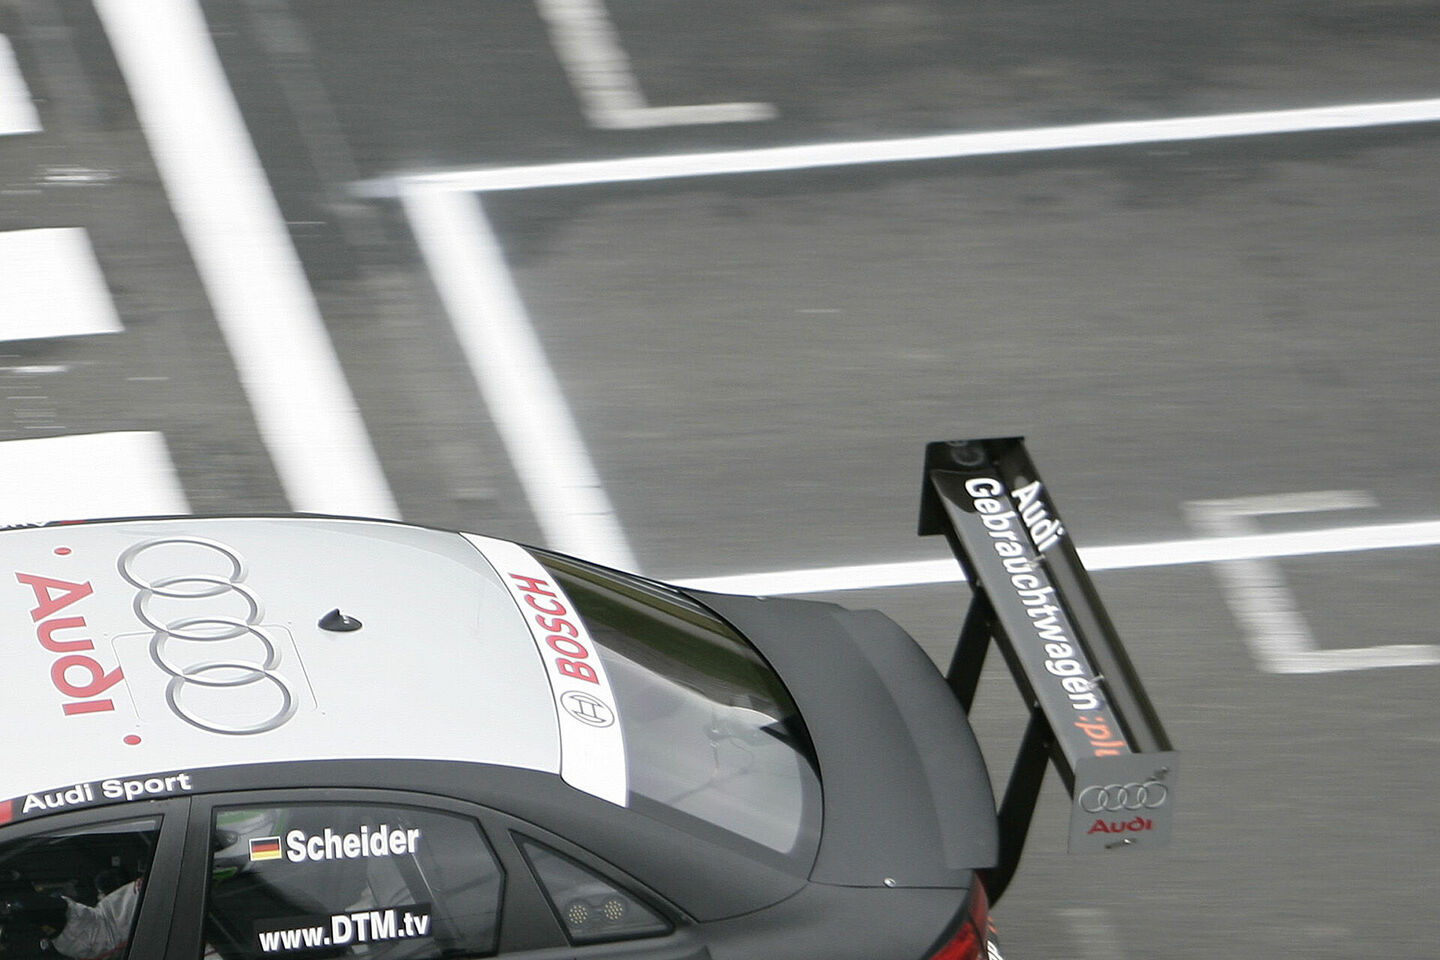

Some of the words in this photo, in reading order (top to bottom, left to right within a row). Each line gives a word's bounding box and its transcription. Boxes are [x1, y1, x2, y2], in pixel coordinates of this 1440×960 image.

[1012, 480, 1065, 551] Audi
[965, 477, 1101, 710] Gebrauchtwagen
[15, 572, 125, 716] Audi
[508, 573, 600, 685] BOSCH
[22, 784, 95, 814] Audi
[102, 773, 192, 801] Sport
[286, 824, 420, 863] Scheider
[1087, 816, 1153, 835] Audi
[259, 909, 430, 952] www.DTM.tv
